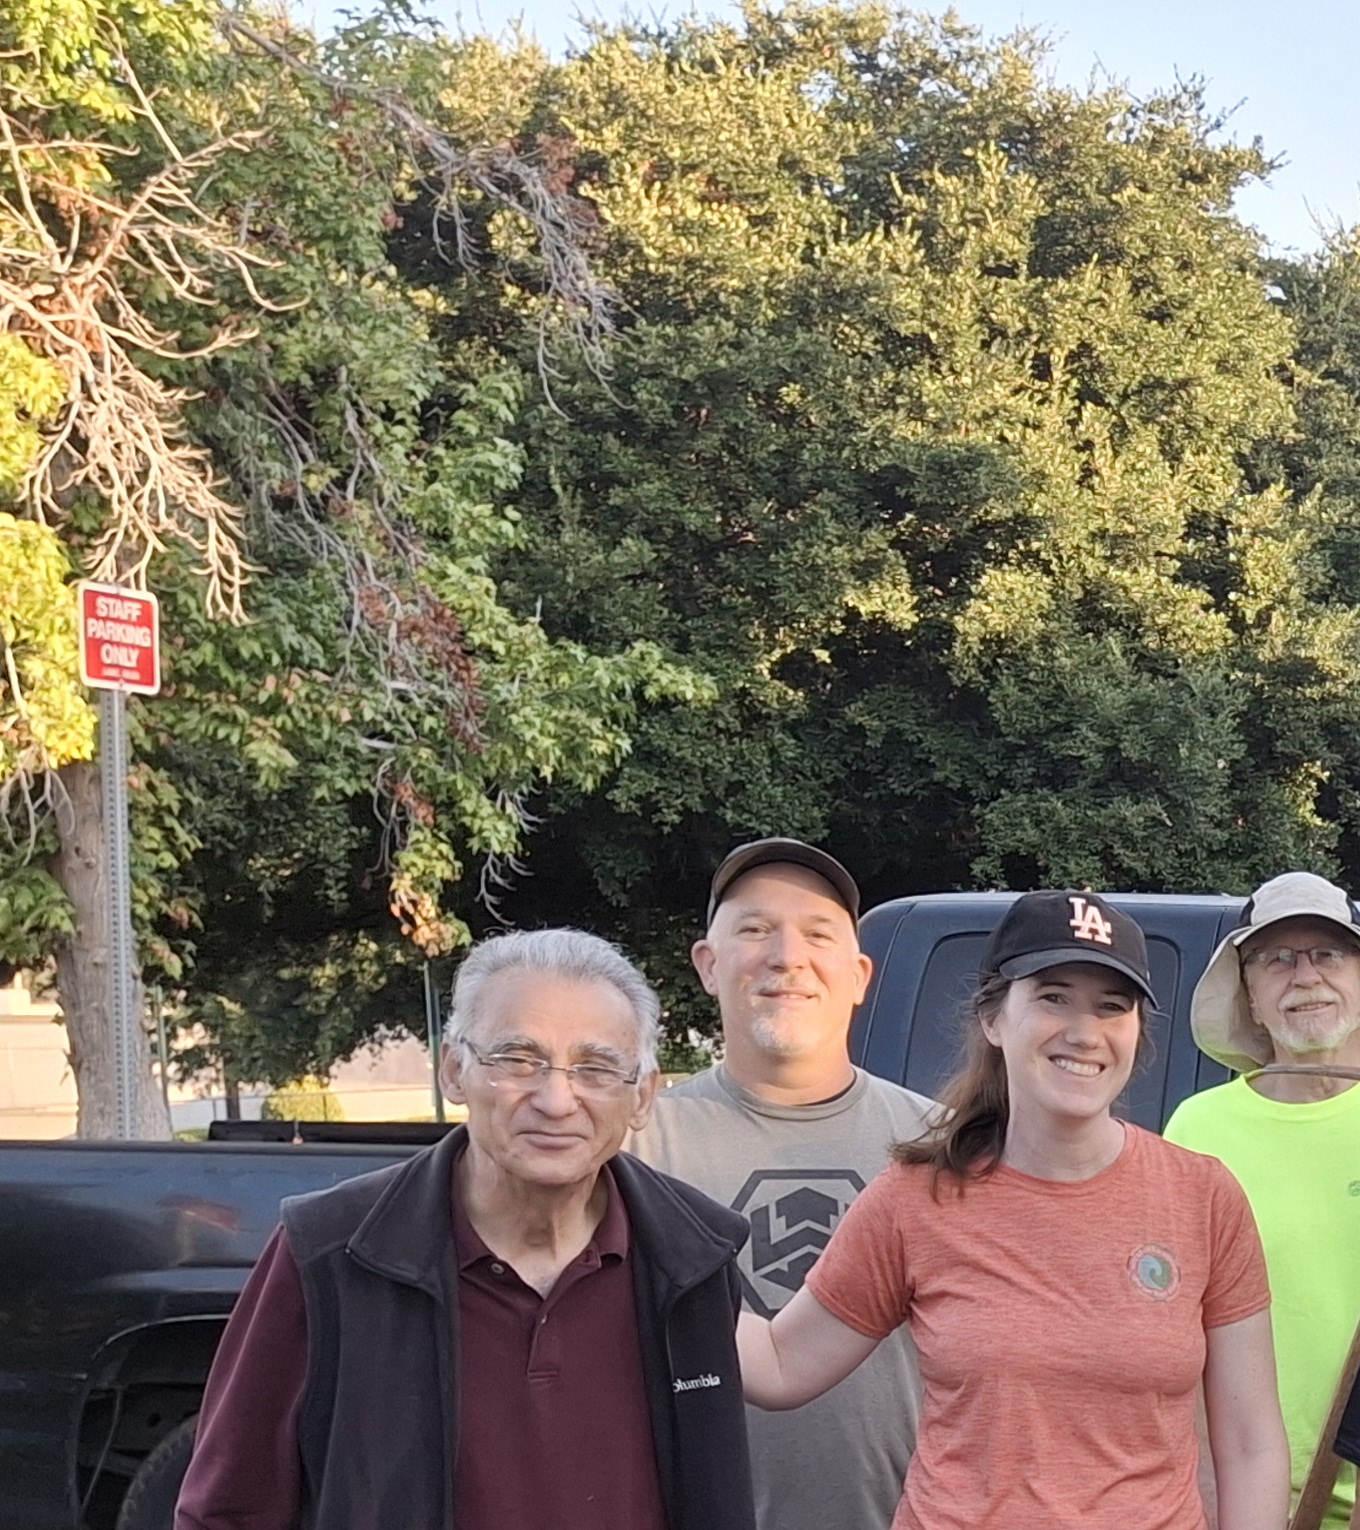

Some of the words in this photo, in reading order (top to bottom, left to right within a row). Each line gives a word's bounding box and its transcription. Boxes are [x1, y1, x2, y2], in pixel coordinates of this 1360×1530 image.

[95, 595, 142, 622] STAFF
[87, 617, 152, 648] PARKING
[101, 643, 140, 669] ONLY
[1068, 897, 1112, 946] LA
